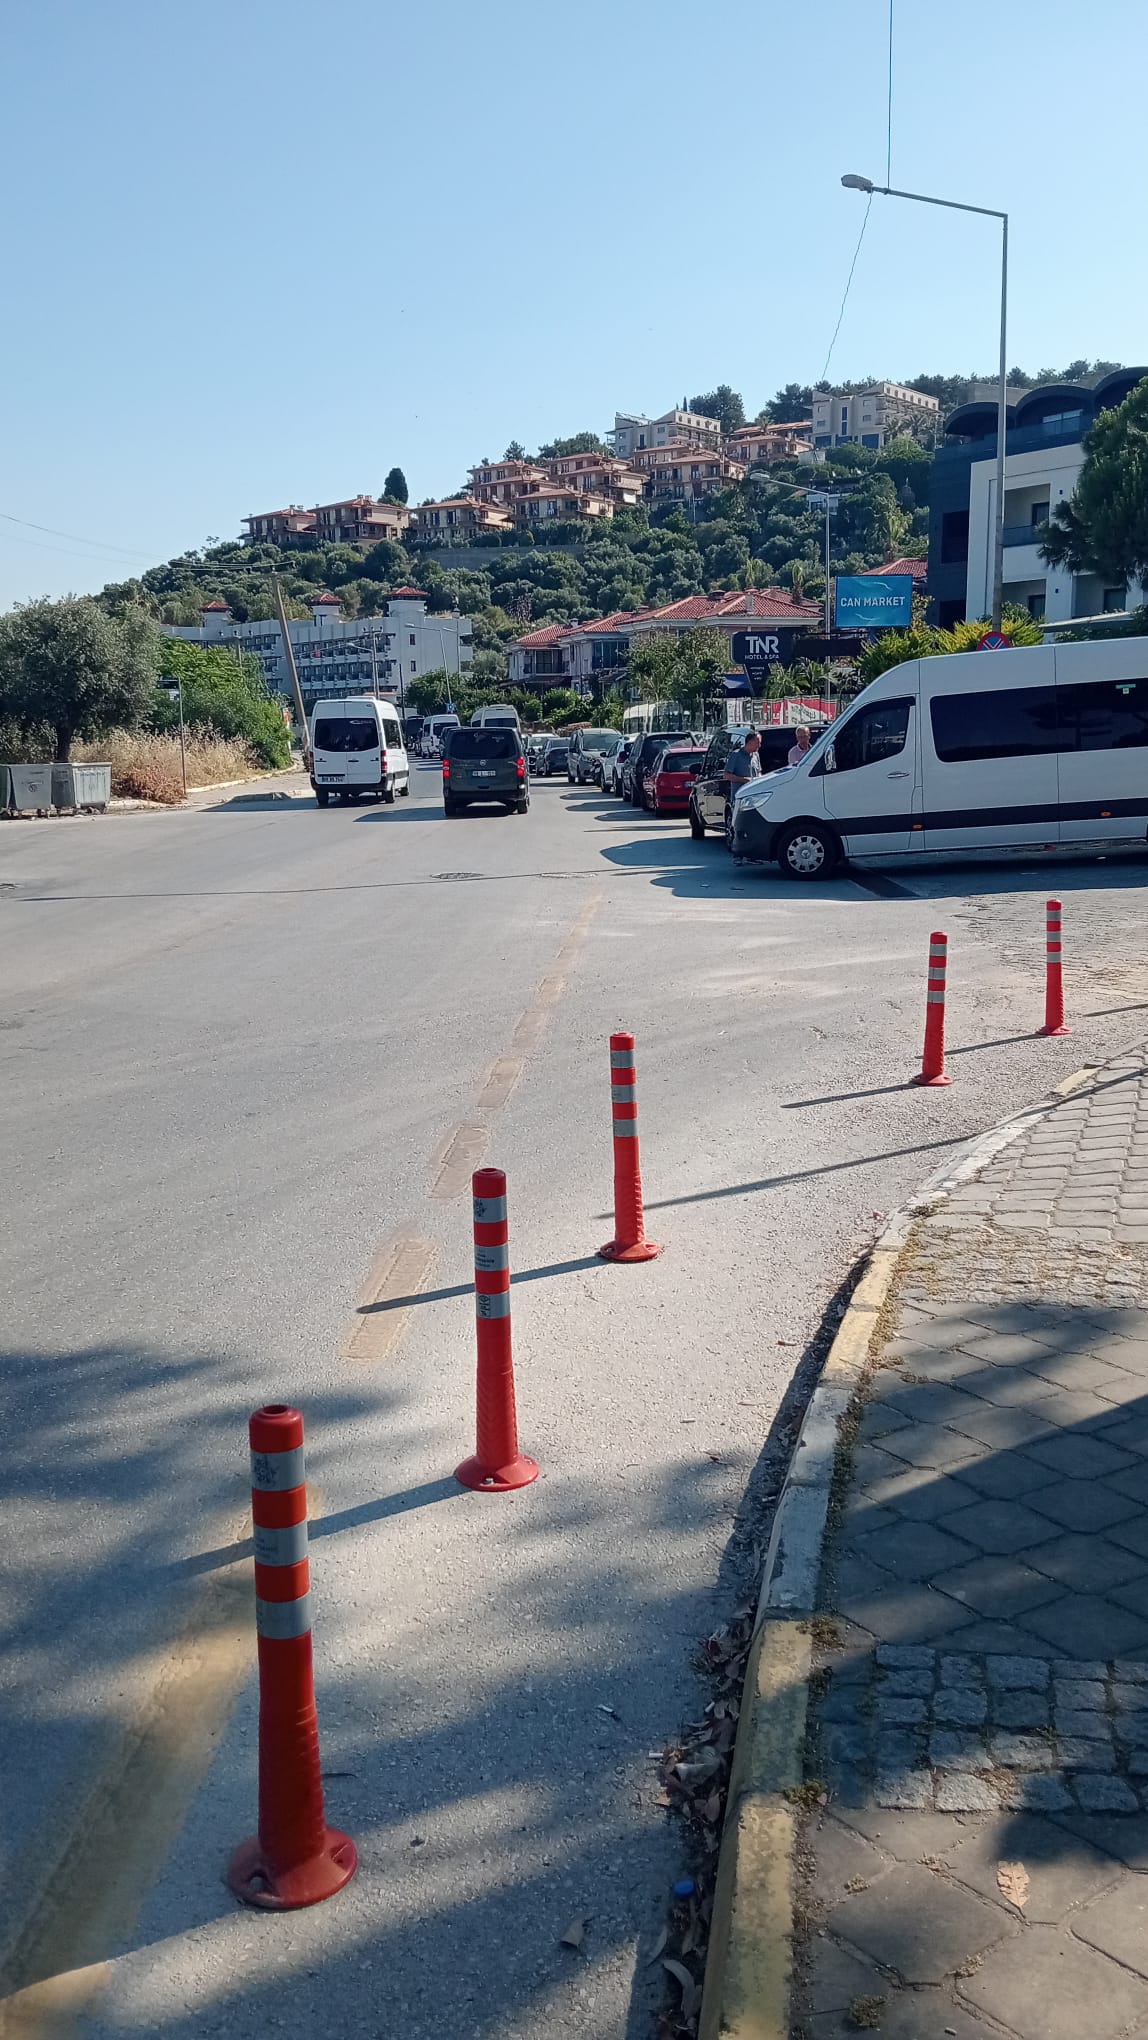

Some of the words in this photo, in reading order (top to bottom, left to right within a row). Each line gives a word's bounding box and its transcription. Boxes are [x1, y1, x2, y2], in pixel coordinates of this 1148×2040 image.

[840, 597, 861, 607] CAN
[863, 596, 905, 607] MARKET
[744, 635, 779, 654] TNR
